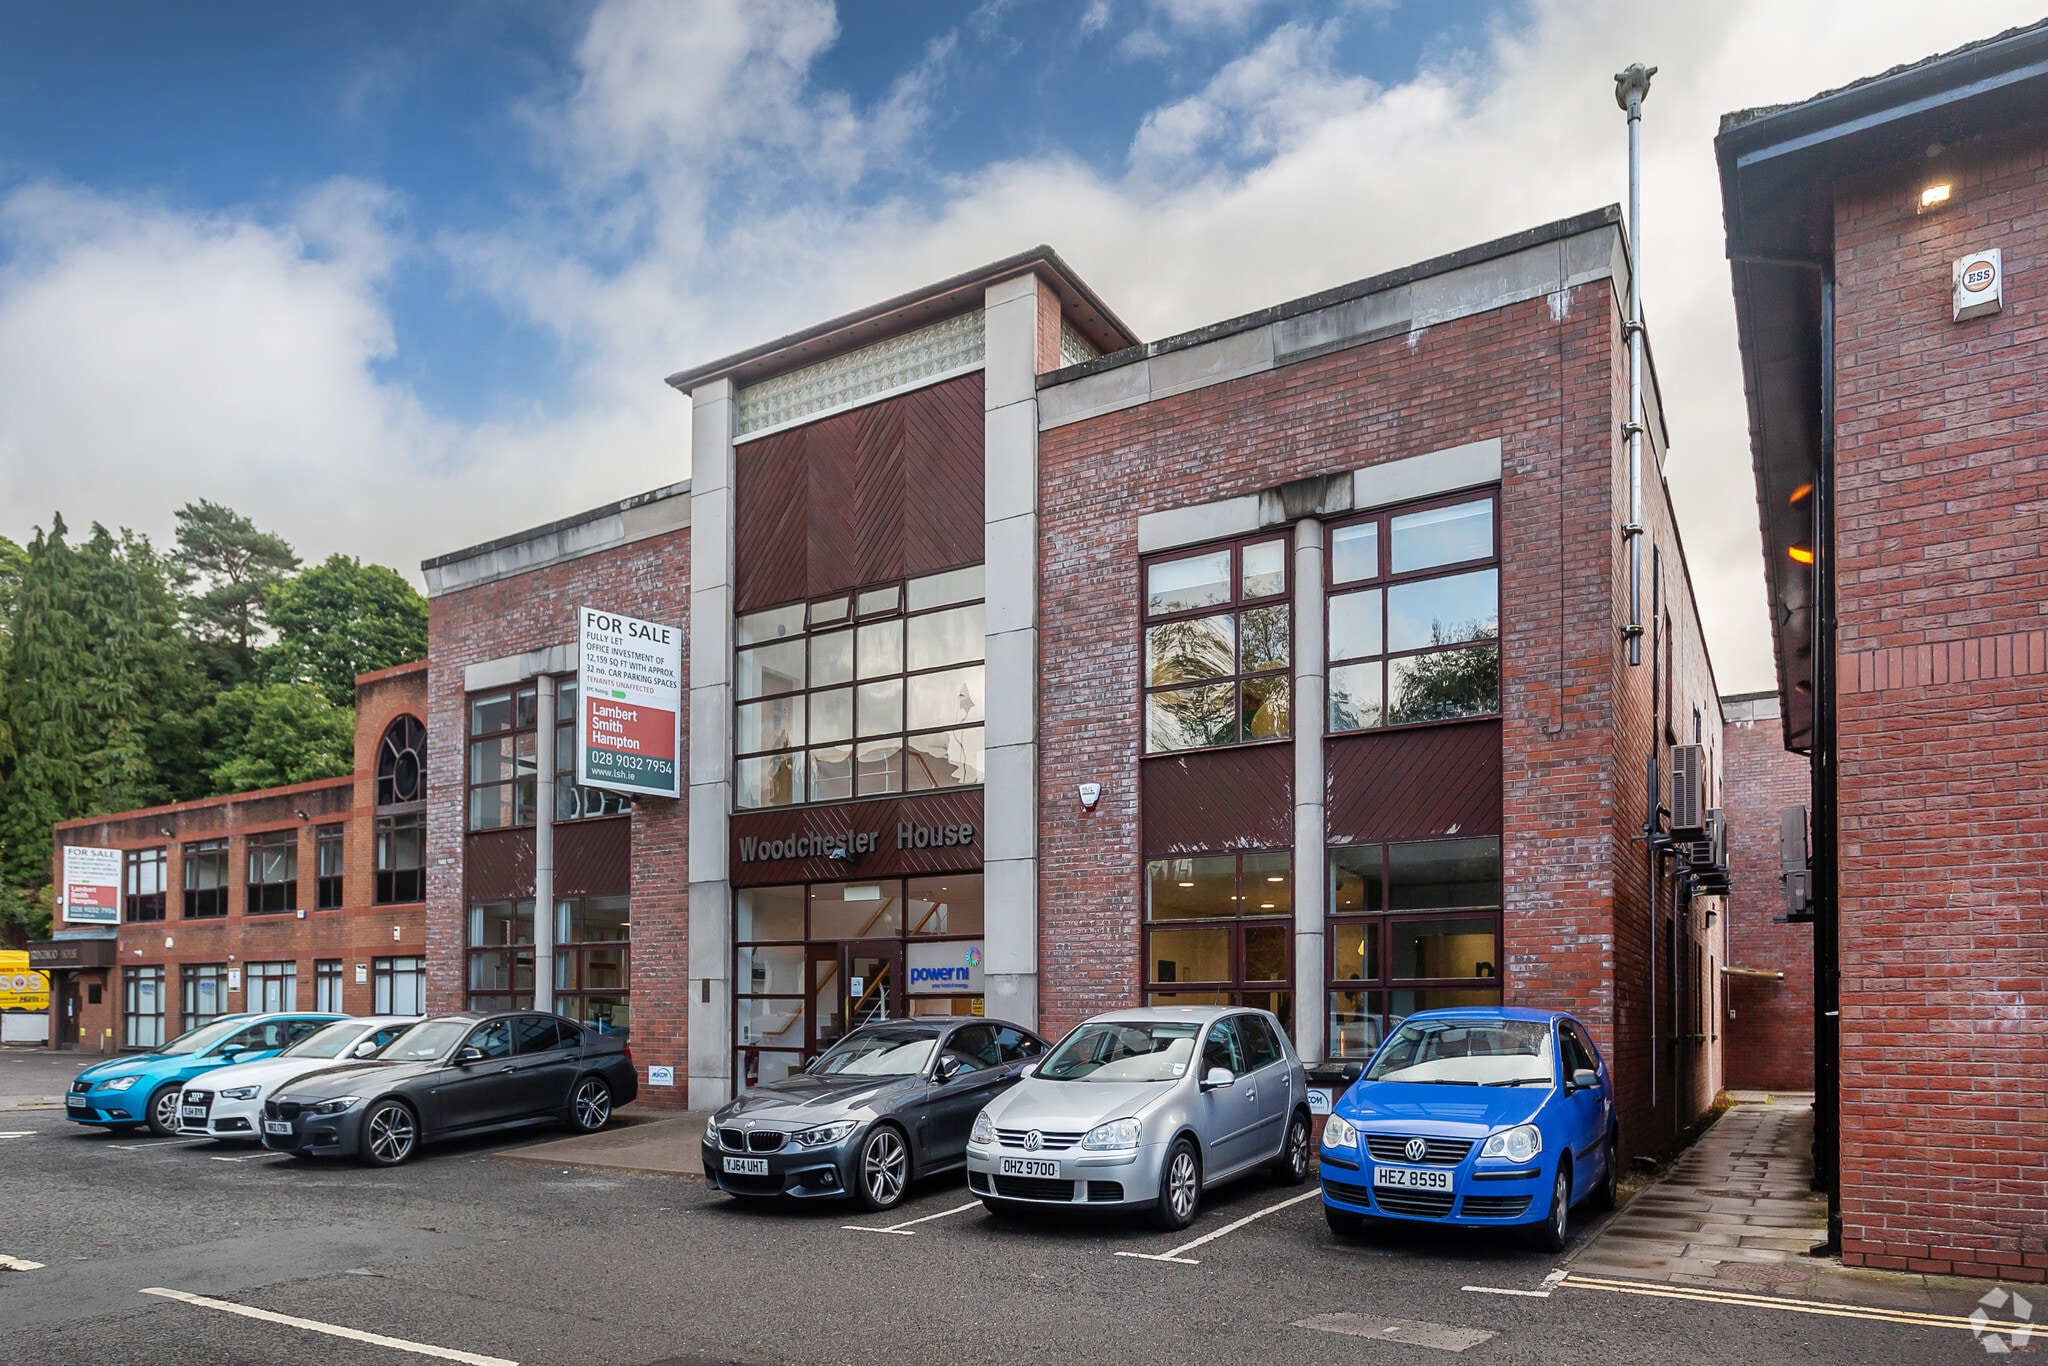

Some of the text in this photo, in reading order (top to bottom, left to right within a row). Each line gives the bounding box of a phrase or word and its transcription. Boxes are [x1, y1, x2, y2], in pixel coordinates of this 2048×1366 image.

[1968, 270, 1990, 283] ESS
[587, 612, 670, 644] FOR SALE
[587, 632, 623, 646] FULLY LET
[586, 642, 664, 664] OFFICE INVESTMENT OF
[586, 664, 594, 672] 32
[608, 668, 622, 678] CAR
[624, 672, 652, 684] PARKING
[654, 678, 677, 688] SPACES
[610, 659, 618, 668] SQ
[621, 660, 627, 668] FT
[629, 662, 646, 672] WITH
[648, 666, 675, 678] APPROX.
[587, 676, 654, 693] TENANTS UNAFFECTED
[592, 702, 638, 722] Lambert
[592, 716, 623, 733] Smith
[592, 730, 640, 749] Hampton
[592, 751, 672, 774] 028 9032 7954
[591, 768, 635, 780] www.lsh.ie
[739, 821, 973, 862] Woodchester House
[911, 967, 955, 984] power
[727, 1159, 764, 1172] YJ64 UHT
[1004, 1160, 1054, 1176] OHZ 9700
[1380, 1169, 1446, 1187] HEZ 8599
